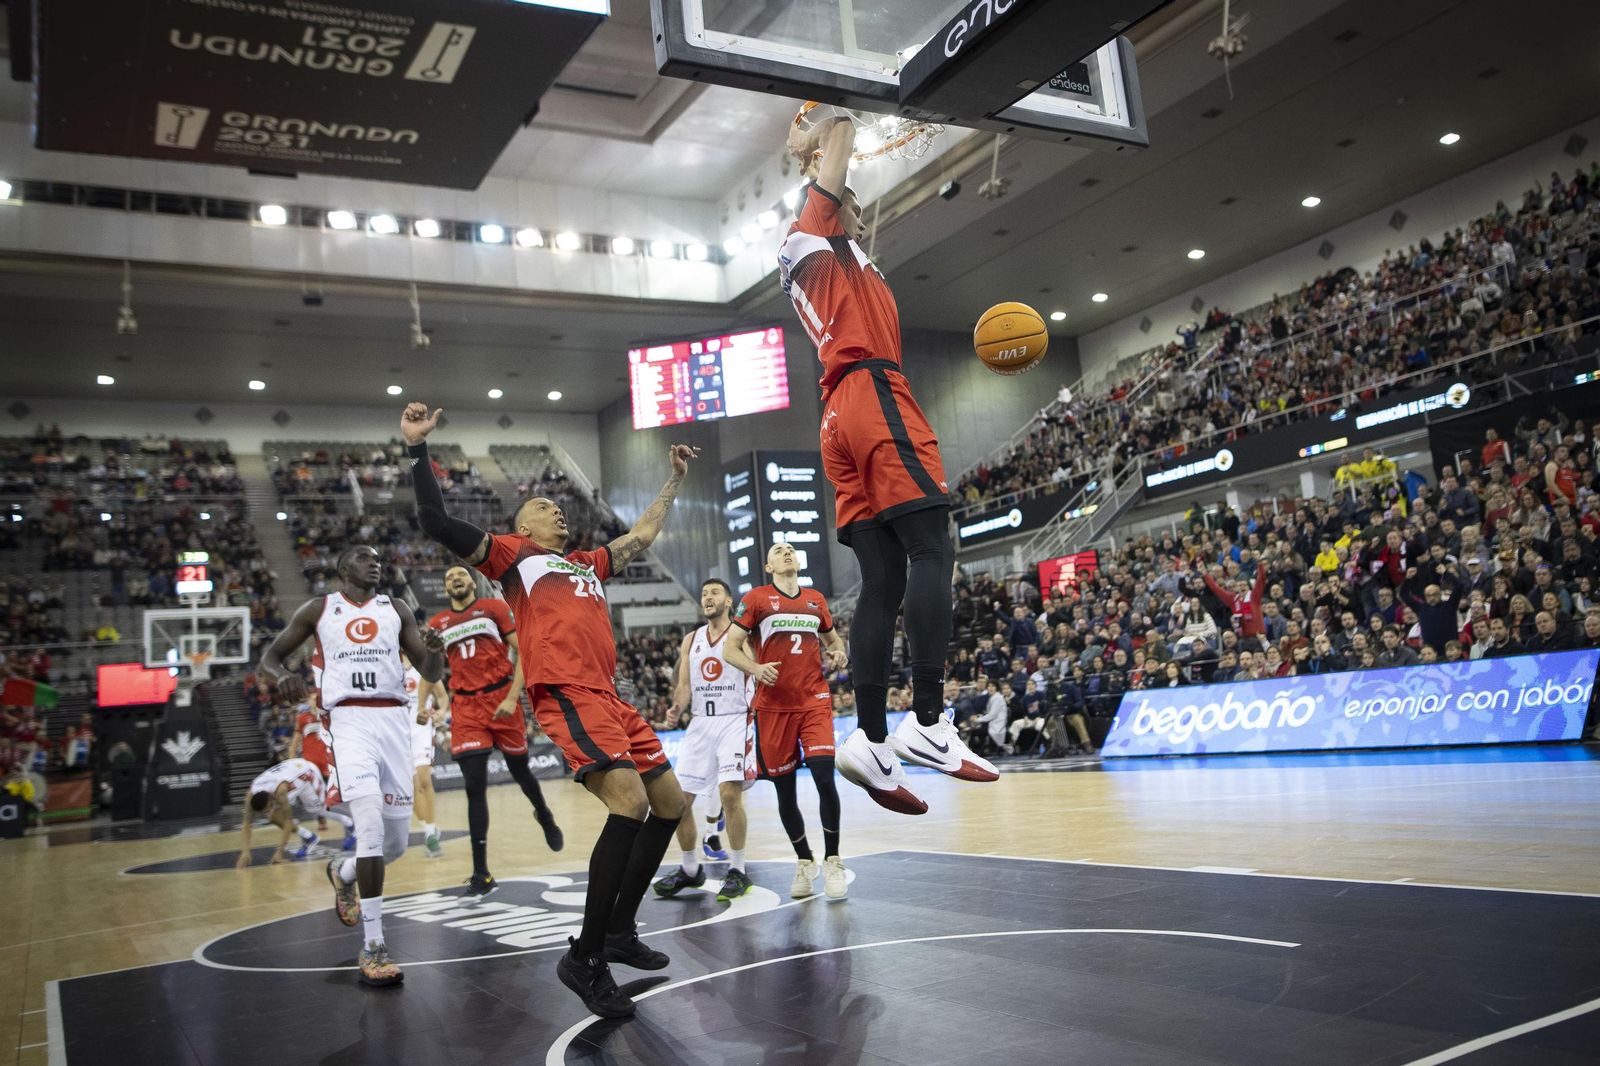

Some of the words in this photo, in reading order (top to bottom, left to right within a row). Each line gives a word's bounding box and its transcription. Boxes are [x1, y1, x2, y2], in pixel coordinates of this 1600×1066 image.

[302, 25, 406, 57] 2031
[169, 28, 394, 77] GRANADA
[1050, 78, 1090, 93] endesa
[218, 126, 311, 149] 2031
[222, 111, 420, 145] GRANADA
[998, 345, 1027, 360] EVO
[458, 638, 476, 660] 17
[790, 633, 803, 655] 2
[351, 671, 377, 691] 44
[705, 700, 716, 717] 0
[1344, 690, 1453, 723] esponjas
[1457, 688, 1510, 711] con
[1132, 690, 1317, 745] begobaño
